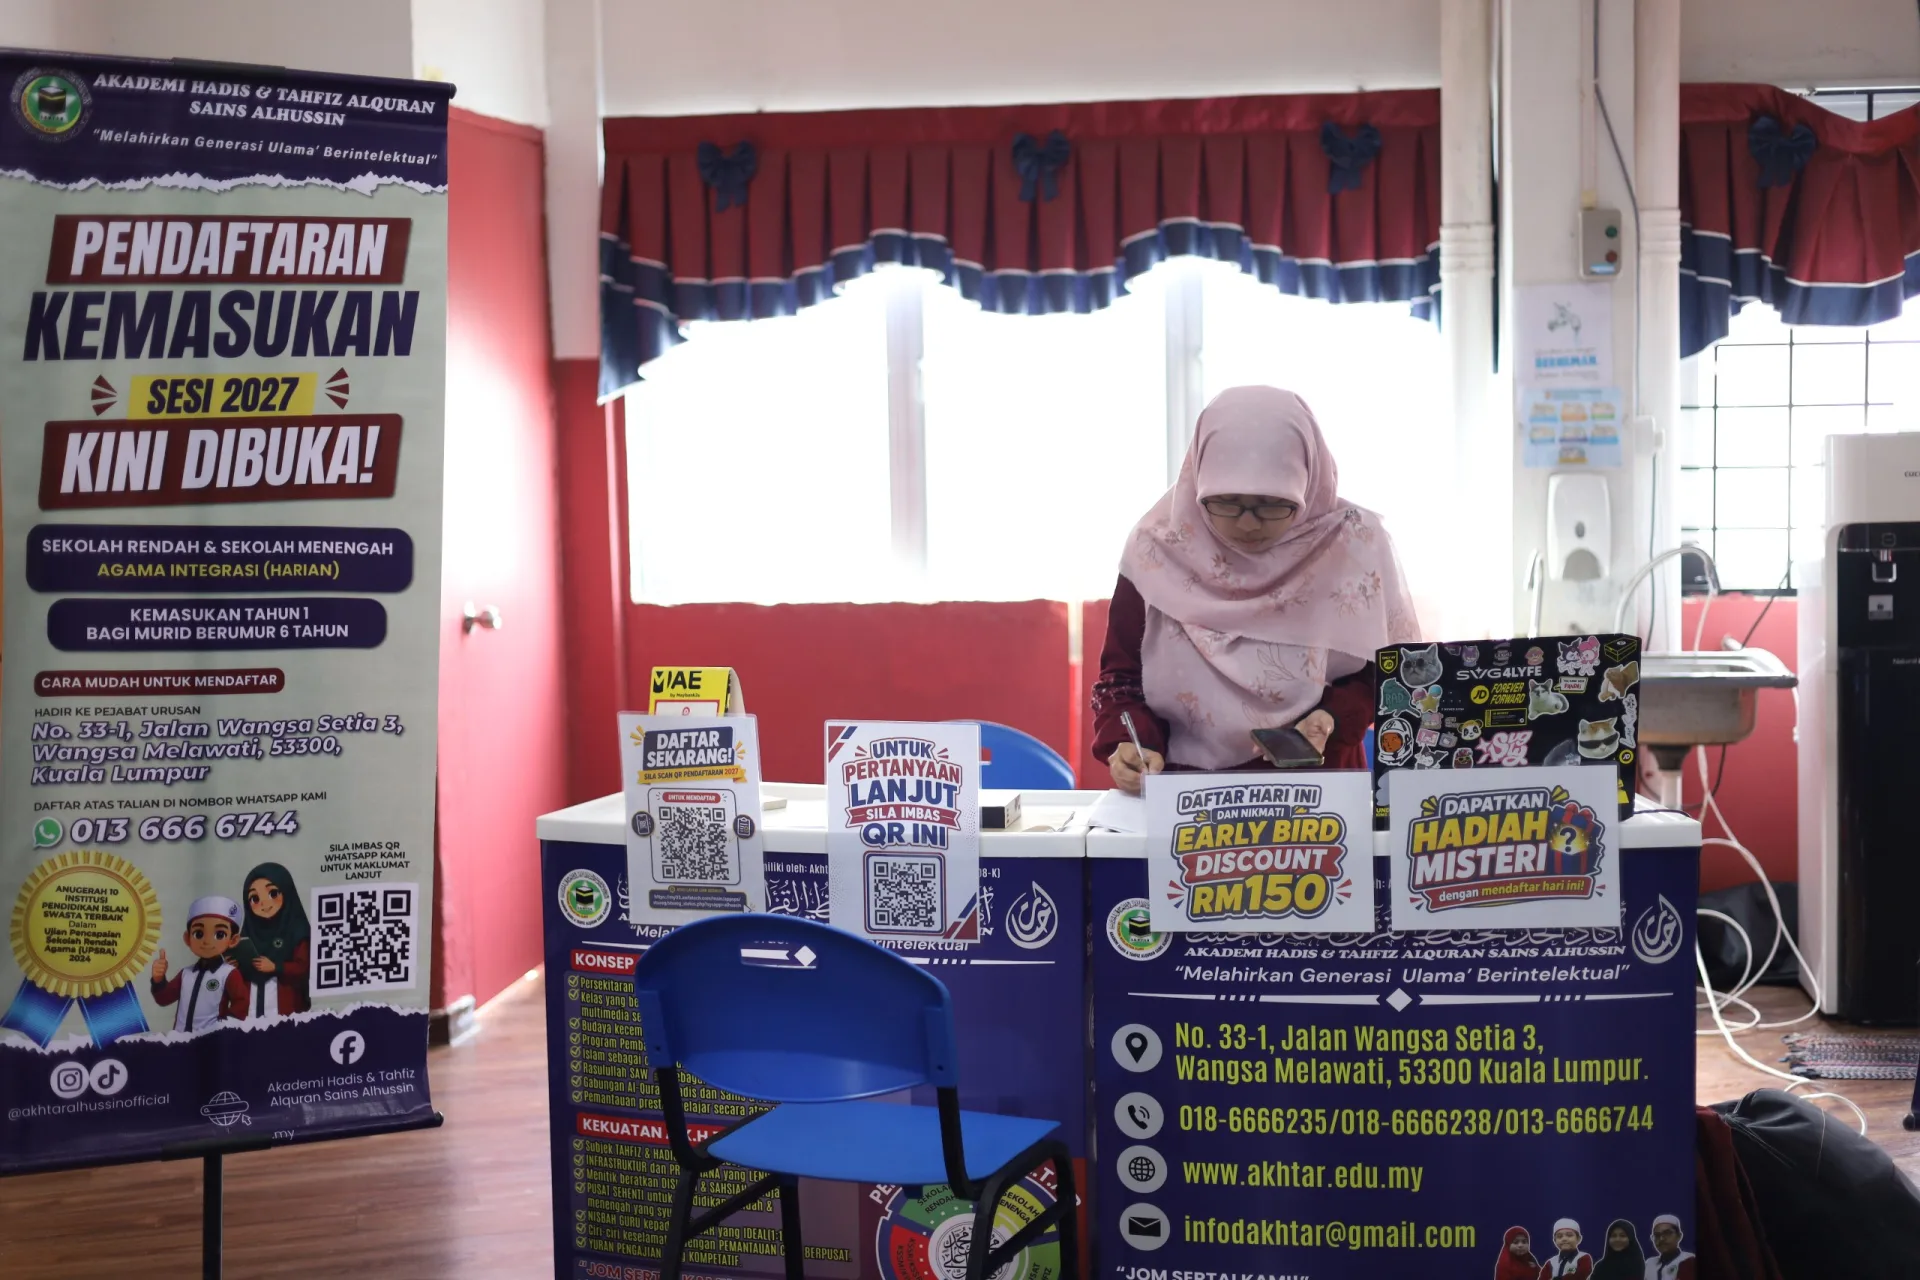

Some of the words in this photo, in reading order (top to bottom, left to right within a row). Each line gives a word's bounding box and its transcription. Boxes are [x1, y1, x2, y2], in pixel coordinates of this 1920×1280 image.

[93, 74, 186, 92] AKADEMI
[191, 81, 250, 97] HADIS
[256, 86, 272, 99] &
[277, 88, 342, 106] TAHFIZ
[346, 95, 436, 114] ALQURAN
[190, 101, 247, 117] SAINS
[251, 106, 346, 126] ALHUSSIN
[195, 136, 263, 151] Generasi
[70, 221, 388, 277] PENDAFTARAN
[23, 289, 420, 361] KEMASUKAN
[147, 378, 214, 415] SESI
[221, 376, 299, 413] 2027
[60, 430, 169, 494] KINI
[181, 425, 380, 490] DIBUKA!
[42, 539, 123, 553] SEKOLAH
[128, 540, 199, 554] RENDAH
[204, 540, 217, 554] &
[221, 540, 294, 554] SEKOLAH
[298, 541, 393, 555] MENENGAH
[97, 563, 166, 577] AGAMA
[171, 563, 259, 577] INTEGRASI
[263, 560, 340, 580] (HARIAN)
[130, 608, 240, 621] KEMASUKAN
[244, 607, 300, 620] TAHUN
[303, 606, 309, 620] 1
[86, 627, 129, 640] BAGI
[135, 626, 192, 640] MURID
[196, 626, 276, 640] BERUMUR
[280, 625, 289, 638] 6
[292, 624, 349, 638] TAHUN
[41, 677, 81, 689] CARA
[85, 677, 140, 688] MUDAH
[143, 676, 191, 687] UNTUK
[194, 674, 277, 687] MENDAFTAR
[1491, 682, 1524, 693] FOREVER
[1490, 693, 1526, 705] FORWARD
[34, 708, 72, 717] HADIR
[75, 707, 91, 716] KE
[94, 706, 148, 716] PEJABAT
[151, 706, 201, 715] URUSAN
[31, 722, 71, 741] No.
[78, 721, 133, 742] 33-1,
[139, 719, 209, 738] Jalan
[217, 718, 312, 738] Wangsa
[317, 712, 378, 732] Setia
[383, 714, 404, 735] 3,
[32, 744, 137, 764] Wangsa
[142, 738, 264, 760] Melawati,
[270, 736, 342, 756] 53300,
[656, 731, 720, 750] DAFTAR
[872, 740, 932, 759] UNTUK
[646, 748, 732, 768] SEKARANG!
[31, 765, 105, 785] Kuala
[111, 765, 210, 785] Lumpur
[683, 769, 723, 777] PENDAFTARAN
[845, 758, 960, 783] PERTANYAAN
[34, 801, 81, 811] DAFTAR
[84, 800, 114, 810] ATAS
[117, 799, 159, 809] TALIAN
[163, 799, 175, 808] DI
[179, 797, 233, 807] NOMBOR
[236, 793, 298, 805] WHATSAPP
[301, 791, 327, 801] KAMI
[851, 778, 958, 808] LANJUT
[1181, 790, 1244, 810] DAFTAR
[1249, 788, 1290, 803] HARI
[1294, 788, 1317, 803] INI
[1217, 808, 1238, 821] DAN
[1241, 807, 1284, 819] NIKMATI
[1444, 793, 1544, 815] DAPATKAN
[866, 809, 897, 820] SILA
[901, 809, 940, 821] IMBAS
[70, 817, 130, 843] 013
[138, 814, 206, 841] 666
[215, 810, 298, 839] 6744
[863, 822, 905, 845] QR
[912, 824, 946, 846] INI
[1178, 820, 1268, 850] EARLY
[1273, 818, 1340, 843] BIRD
[1413, 810, 1548, 853] HADIAH
[324, 851, 378, 862] WHATSAPP
[380, 851, 405, 859] KAMI
[329, 843, 349, 852] SILA
[352, 841, 382, 851] IMBAS
[385, 841, 400, 850] QR
[320, 863, 352, 872] UNTUK
[354, 860, 410, 869] MAKLUMAT
[1195, 849, 1328, 877] DISCOUNT
[1415, 843, 1548, 886] MISTERI
[345, 871, 382, 880] LANJUT
[56, 886, 107, 895] ANUGERAH
[65, 894, 108, 904] INSTITUSI
[1192, 874, 1329, 915] RM150
[1439, 888, 1478, 902] dengan
[1481, 882, 1540, 896] mendaftar
[1543, 880, 1564, 891] hari
[1567, 880, 1585, 891] ini!
[42, 902, 99, 911] PENDIDIKAN
[102, 905, 129, 913] ISLAM
[43, 911, 82, 919] SWASTA
[84, 912, 124, 921] TERBAIK
[575, 953, 634, 969] KONSEP
[1184, 947, 1262, 958] AKADEMI
[1266, 948, 1317, 959] HADIS
[1321, 949, 1337, 959] &
[1340, 949, 1398, 959] TAHFIZ
[1402, 949, 1485, 961] ALQURAN
[1488, 948, 1539, 958] SAINS
[1542, 945, 1626, 957] ALHUSSIN
[581, 977, 634, 993] Persekitaran
[1300, 968, 1392, 983] Generasi
[582, 1006, 629, 1020] multimedia
[1175, 1022, 1211, 1048] No.
[1219, 1024, 1275, 1054] 33-1,
[1281, 1025, 1347, 1051] Jalan
[1354, 1025, 1448, 1054] Wangsa
[1455, 1024, 1515, 1051] Setia
[1522, 1024, 1544, 1054] 3,
[267, 1076, 323, 1093] Akademi
[327, 1074, 363, 1087] Hadis
[366, 1072, 375, 1083] &
[379, 1068, 415, 1081] Tahfiz
[1175, 1055, 1267, 1085] Wangsa
[1275, 1057, 1392, 1089] Melawati,
[1398, 1058, 1471, 1085] 53300
[1479, 1058, 1546, 1085] Kuala
[1553, 1057, 1649, 1085] Lumpur.
[270, 1092, 321, 1108] Alquran
[324, 1088, 359, 1101] Sains
[362, 1083, 414, 1097] Alhussin
[8, 1093, 170, 1121] @akhtaralhussinofficial
[583, 1118, 662, 1139] KEKUATAN
[1179, 1104, 1653, 1135] 018-6666235/018-6666238/013-6666744
[1183, 1161, 1424, 1192] www.akhtar.edu.my
[1184, 1216, 1476, 1250] infodakhtar@gmail.com
[719, 1240, 776, 1255] PEMANTAUAN
